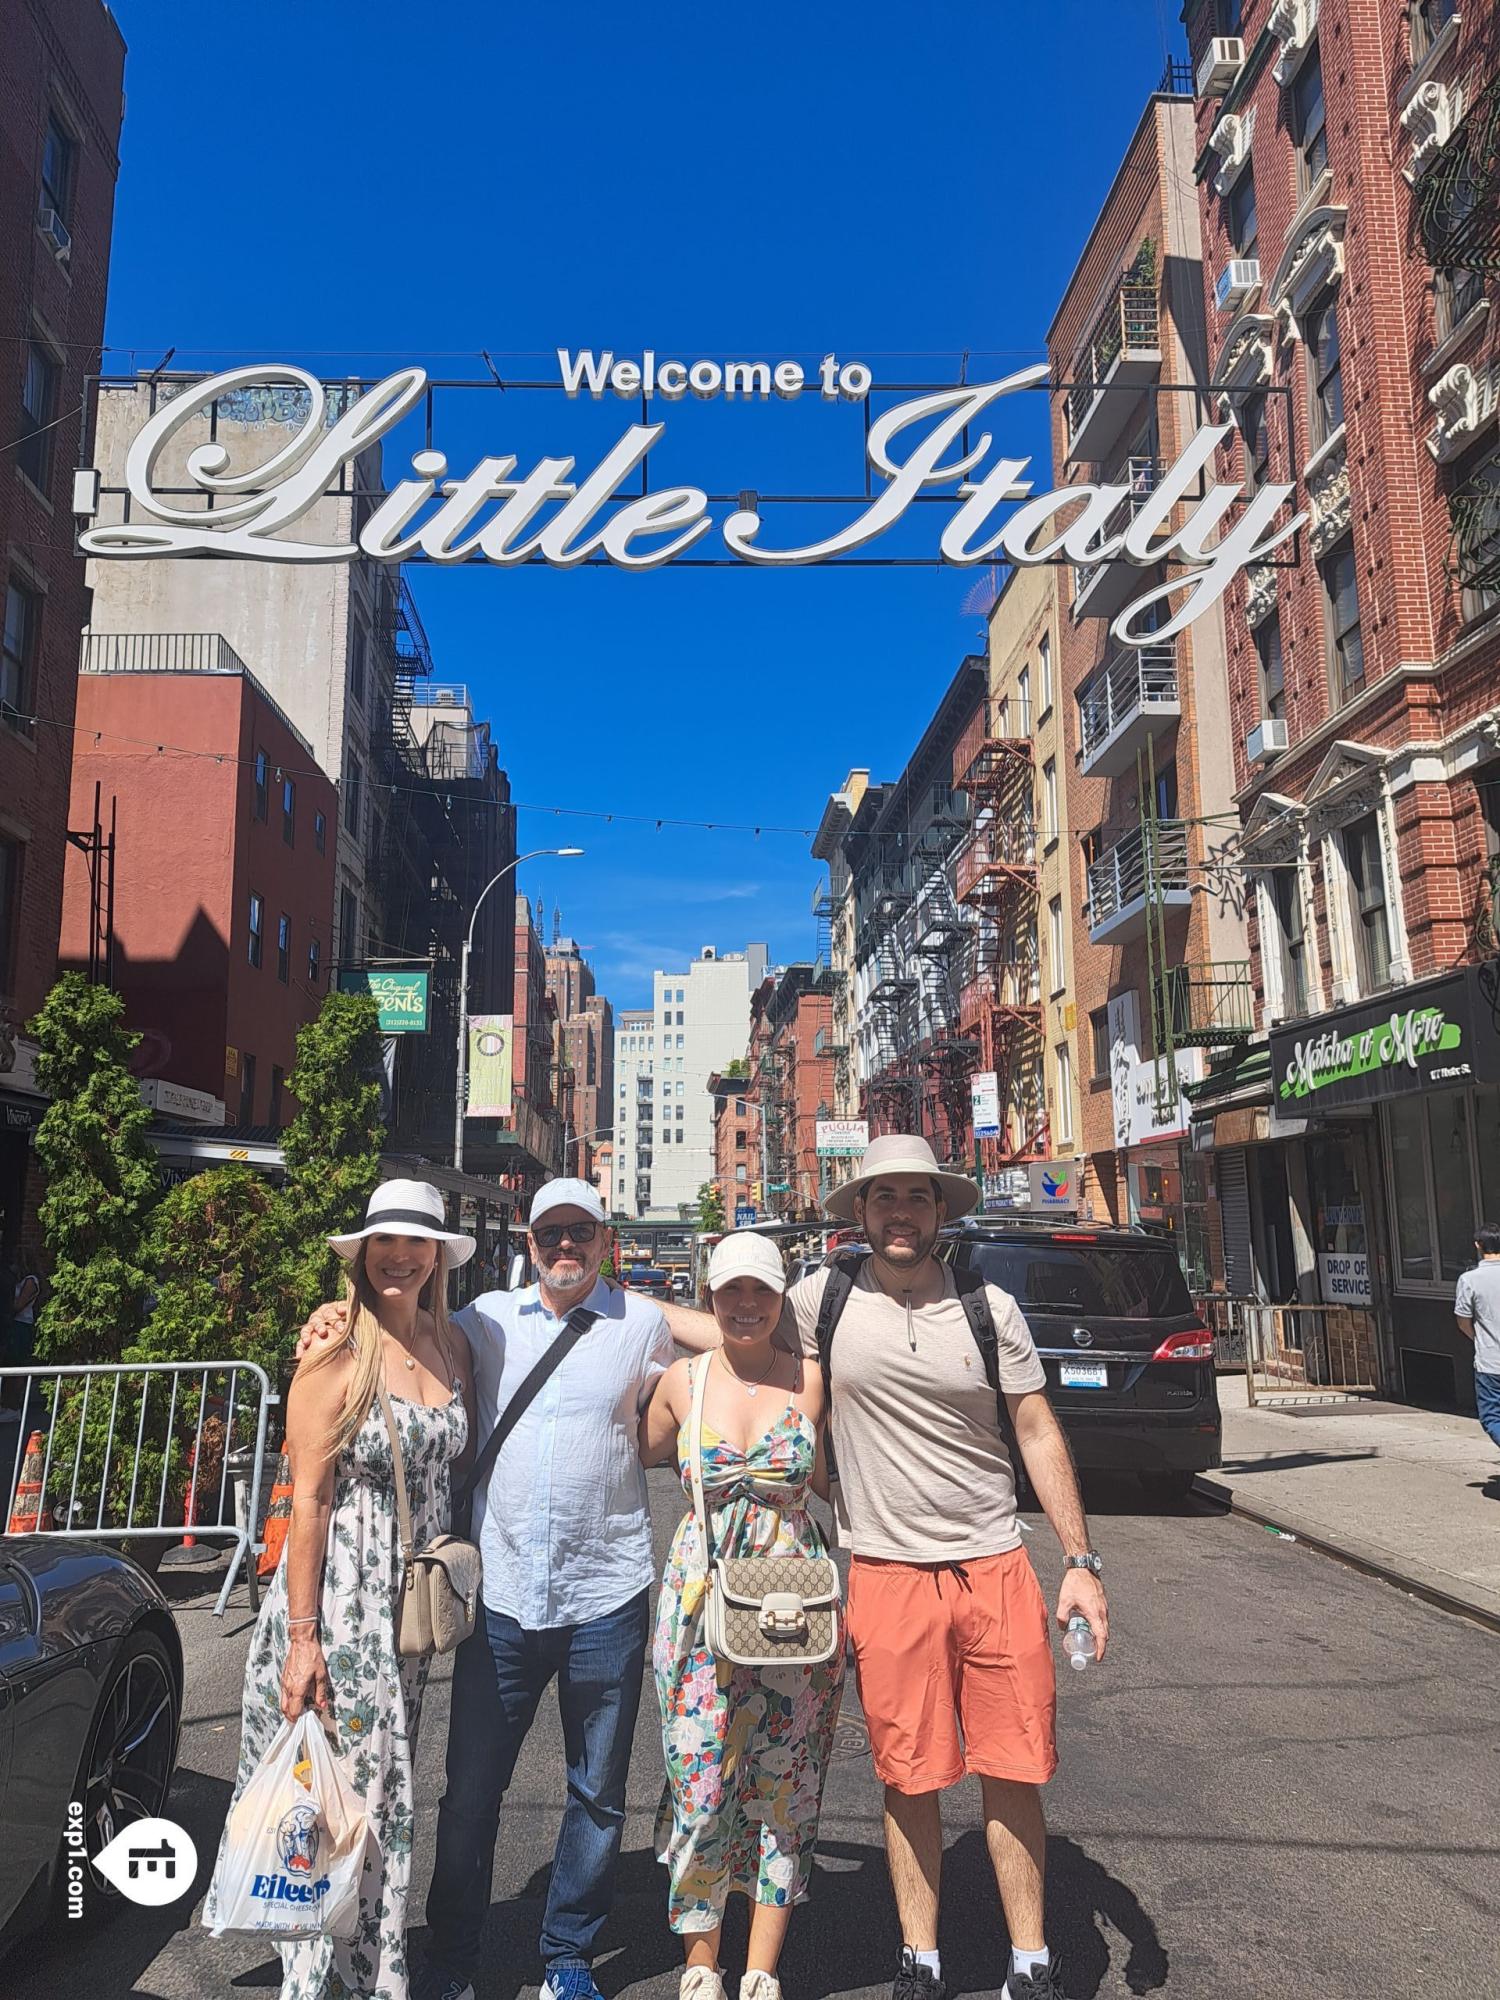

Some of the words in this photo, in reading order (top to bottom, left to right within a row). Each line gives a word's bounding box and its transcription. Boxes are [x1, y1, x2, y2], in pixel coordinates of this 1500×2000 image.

[558, 348, 804, 399] Welcome
[819, 353, 872, 400] to
[78, 363, 713, 571] Little
[723, 363, 1309, 650] Italy
[1286, 1030, 1355, 1089] Matcha
[1379, 1009, 1444, 1068] More
[821, 1122, 865, 1134] PUGLIA
[736, 1213, 755, 1221] NAIL
[1327, 1259, 1350, 1275] DROP
[1331, 1278, 1371, 1295] SERVICE
